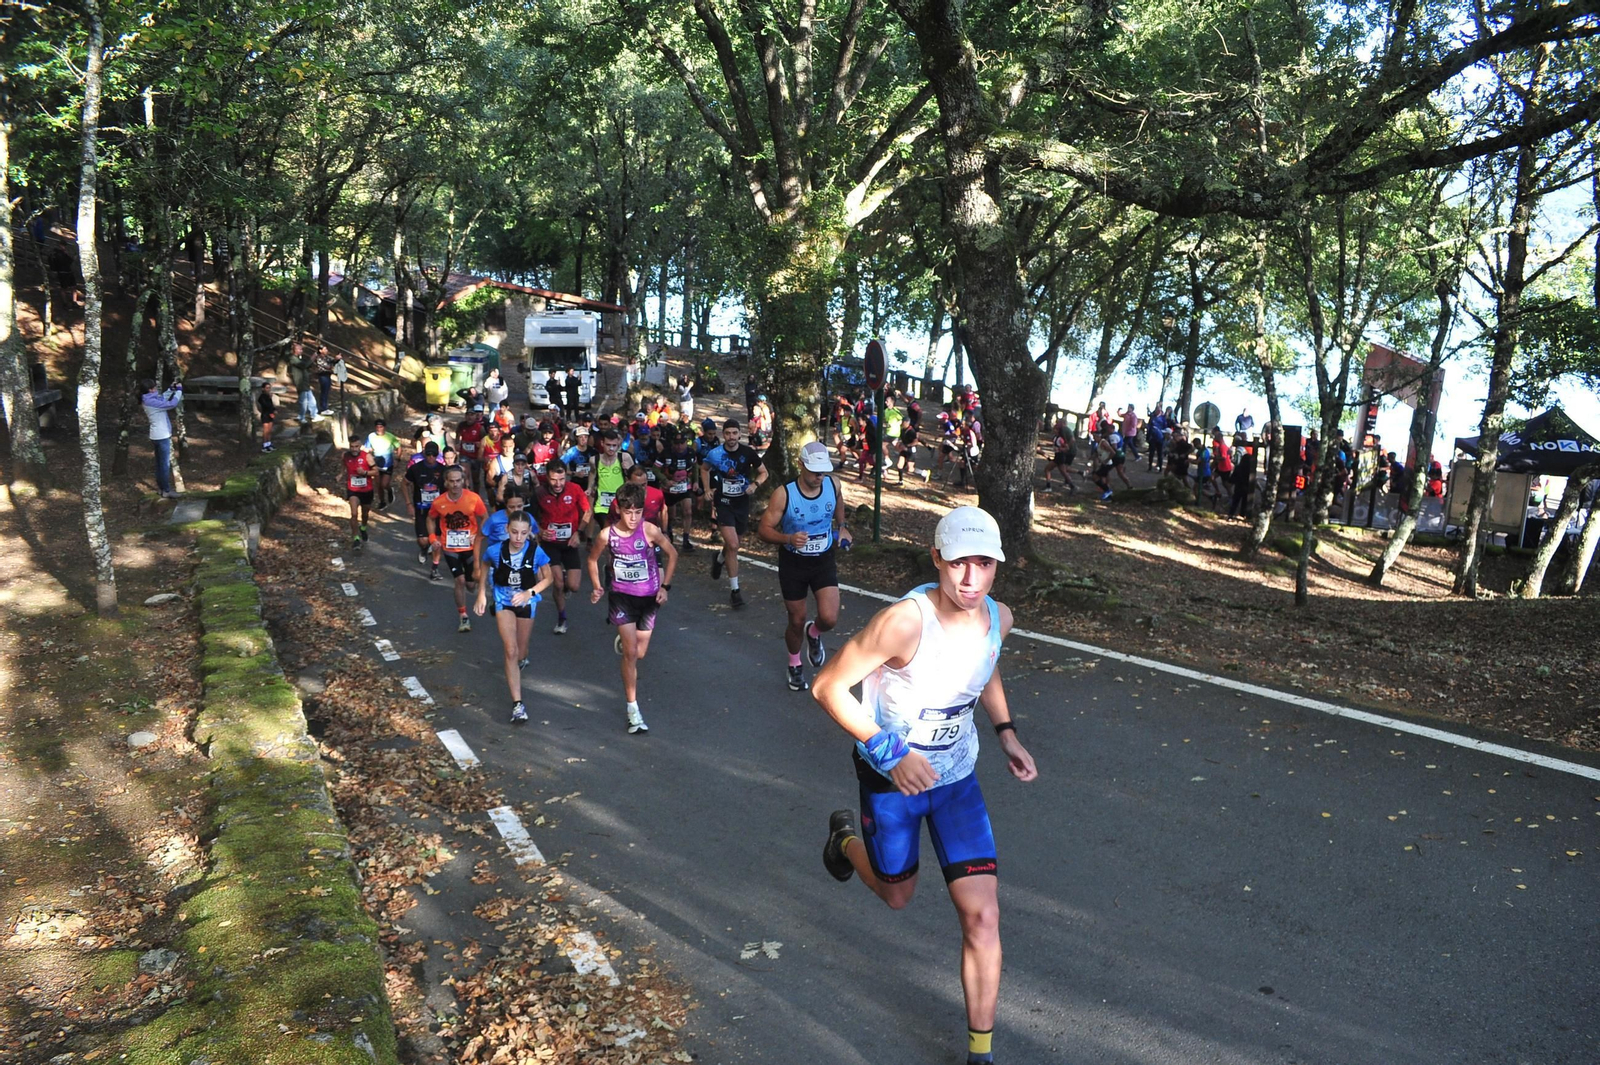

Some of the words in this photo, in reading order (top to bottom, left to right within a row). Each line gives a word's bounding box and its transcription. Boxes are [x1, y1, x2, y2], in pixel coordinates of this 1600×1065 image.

[805, 543, 820, 551] 135
[622, 571, 640, 579] 186
[931, 724, 960, 742] 179
